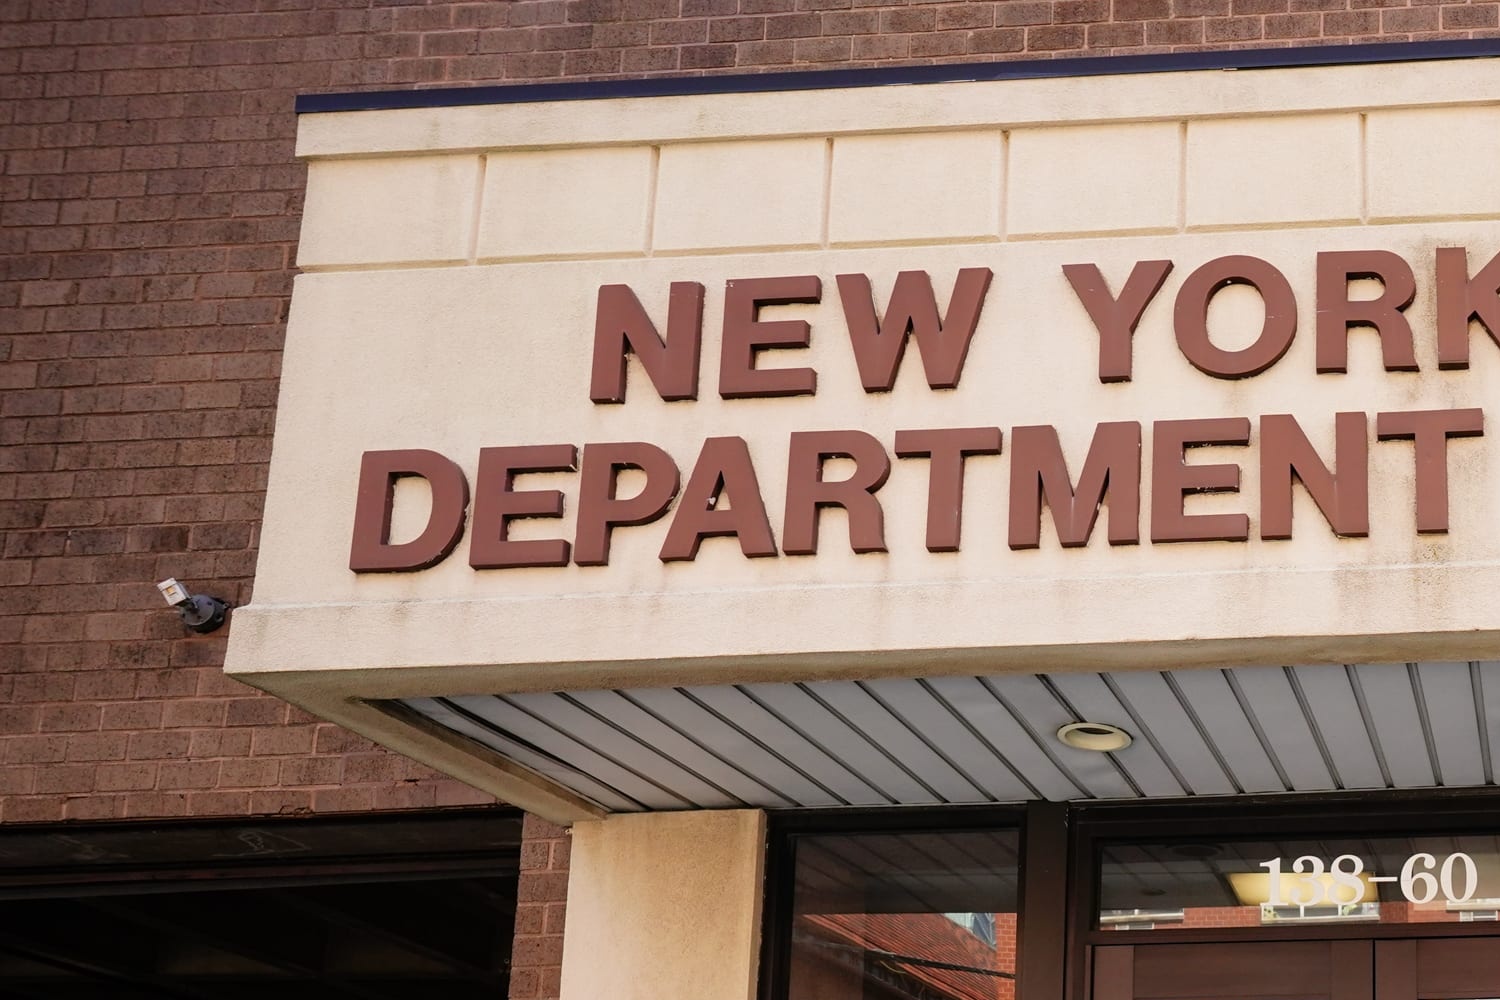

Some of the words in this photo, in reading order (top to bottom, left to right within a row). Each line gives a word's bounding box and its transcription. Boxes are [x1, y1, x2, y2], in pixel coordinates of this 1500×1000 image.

[589, 267, 994, 404] NEW
[349, 408, 1484, 575] DEPARTMENT
[1259, 852, 1478, 907] 138-60
